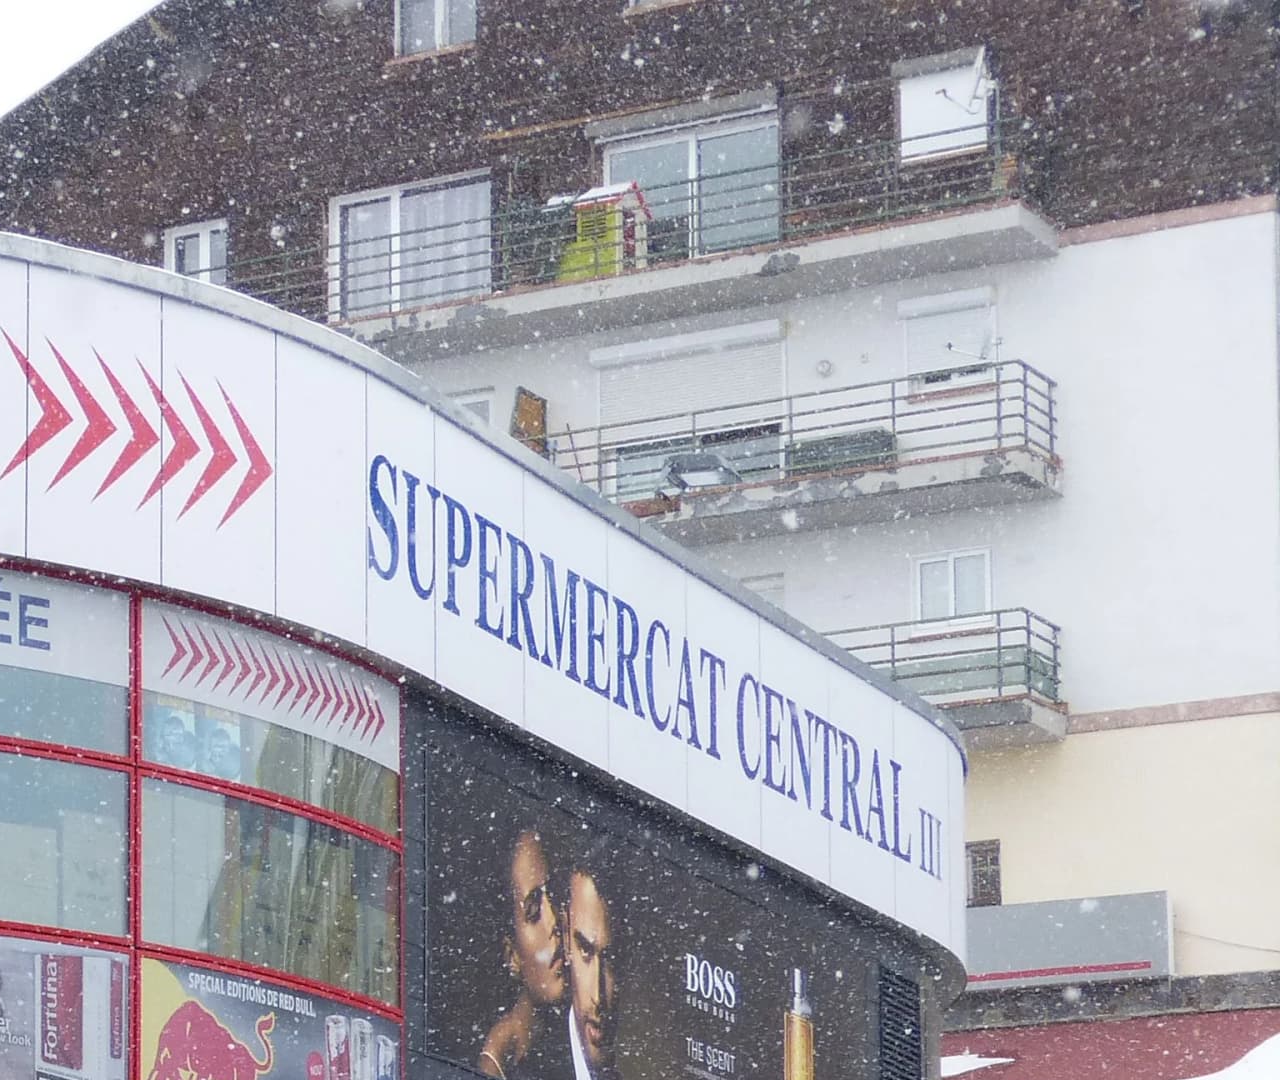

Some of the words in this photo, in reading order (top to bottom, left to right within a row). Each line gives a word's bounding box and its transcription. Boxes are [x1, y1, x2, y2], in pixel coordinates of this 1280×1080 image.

[367, 454, 727, 761] SUPERMERCAT
[735, 671, 912, 863] CENTRAL
[918, 806, 942, 881] III
[188, 972, 226, 995] SPECIAL
[227, 980, 267, 1006] EDITIONS
[267, 990, 279, 1008] DE
[279, 992, 295, 1012] RED
[685, 952, 736, 1009] BOSS
[8, 1032, 32, 1047] look
[685, 1037, 705, 1062] THE
[705, 1045, 736, 1073] SCENT
